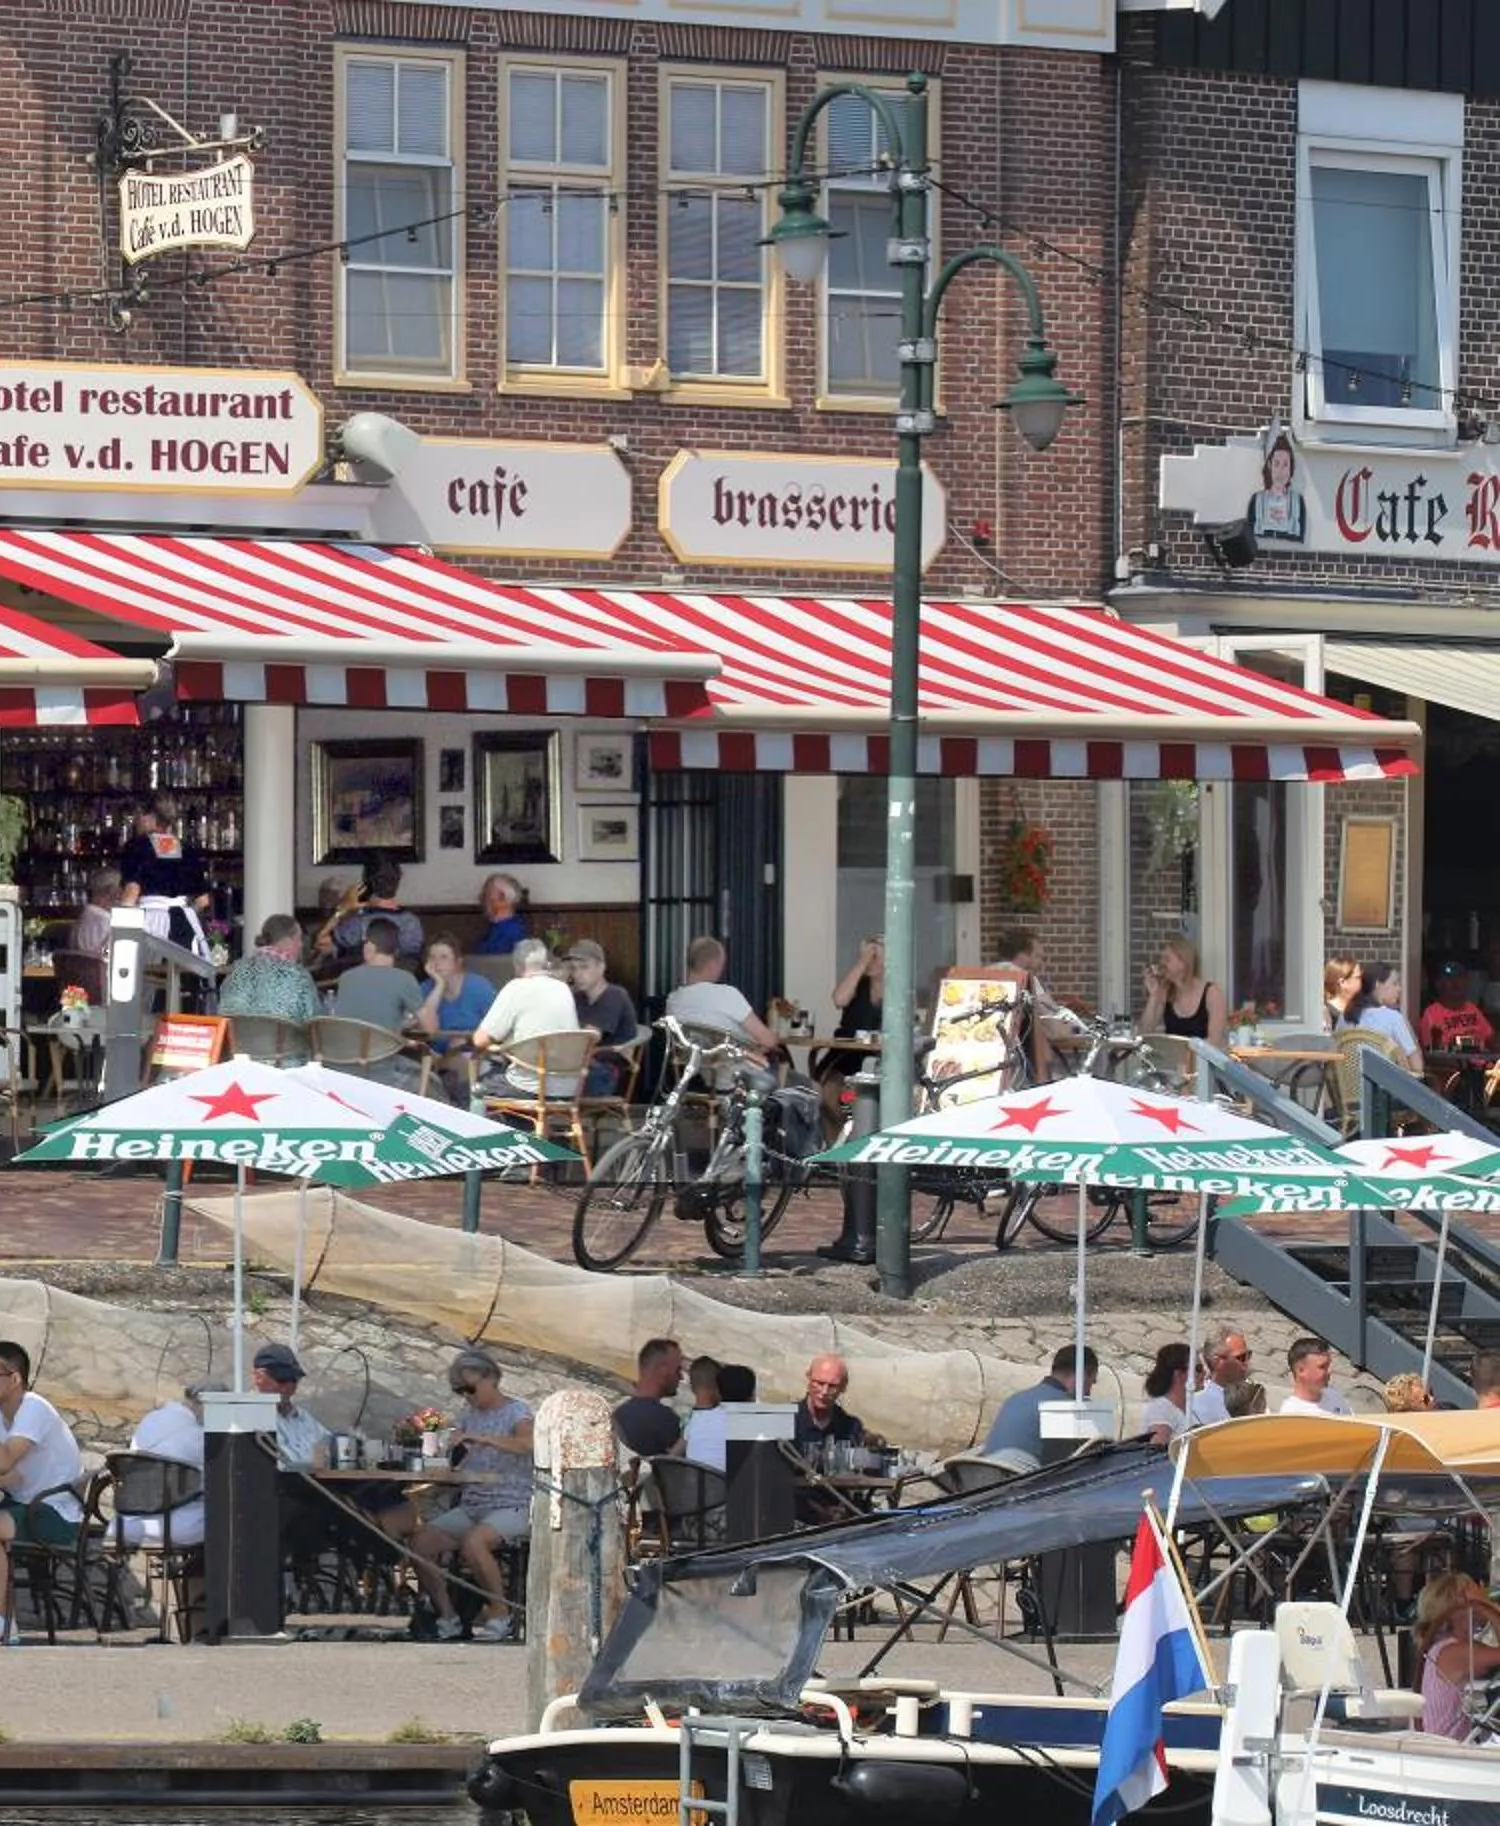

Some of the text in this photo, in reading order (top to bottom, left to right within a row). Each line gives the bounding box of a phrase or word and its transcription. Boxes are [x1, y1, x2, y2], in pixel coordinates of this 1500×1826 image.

[127, 163, 243, 211] HOTEL RESTAURANT
[159, 212, 185, 240] v.d.
[190, 204, 243, 237] HOGEN
[79, 384, 294, 420] restaurant
[64, 437, 134, 471] v.d.
[150, 438, 290, 475] HOGEN
[712, 476, 897, 534] brasserie
[1335, 466, 1449, 547] Cafe
[66, 1132, 380, 1161] Heineken
[851, 1136, 1106, 1172] Heineken
[1130, 1144, 1334, 1173] Heineken
[1358, 1794, 1450, 1826] Loosdrecht
